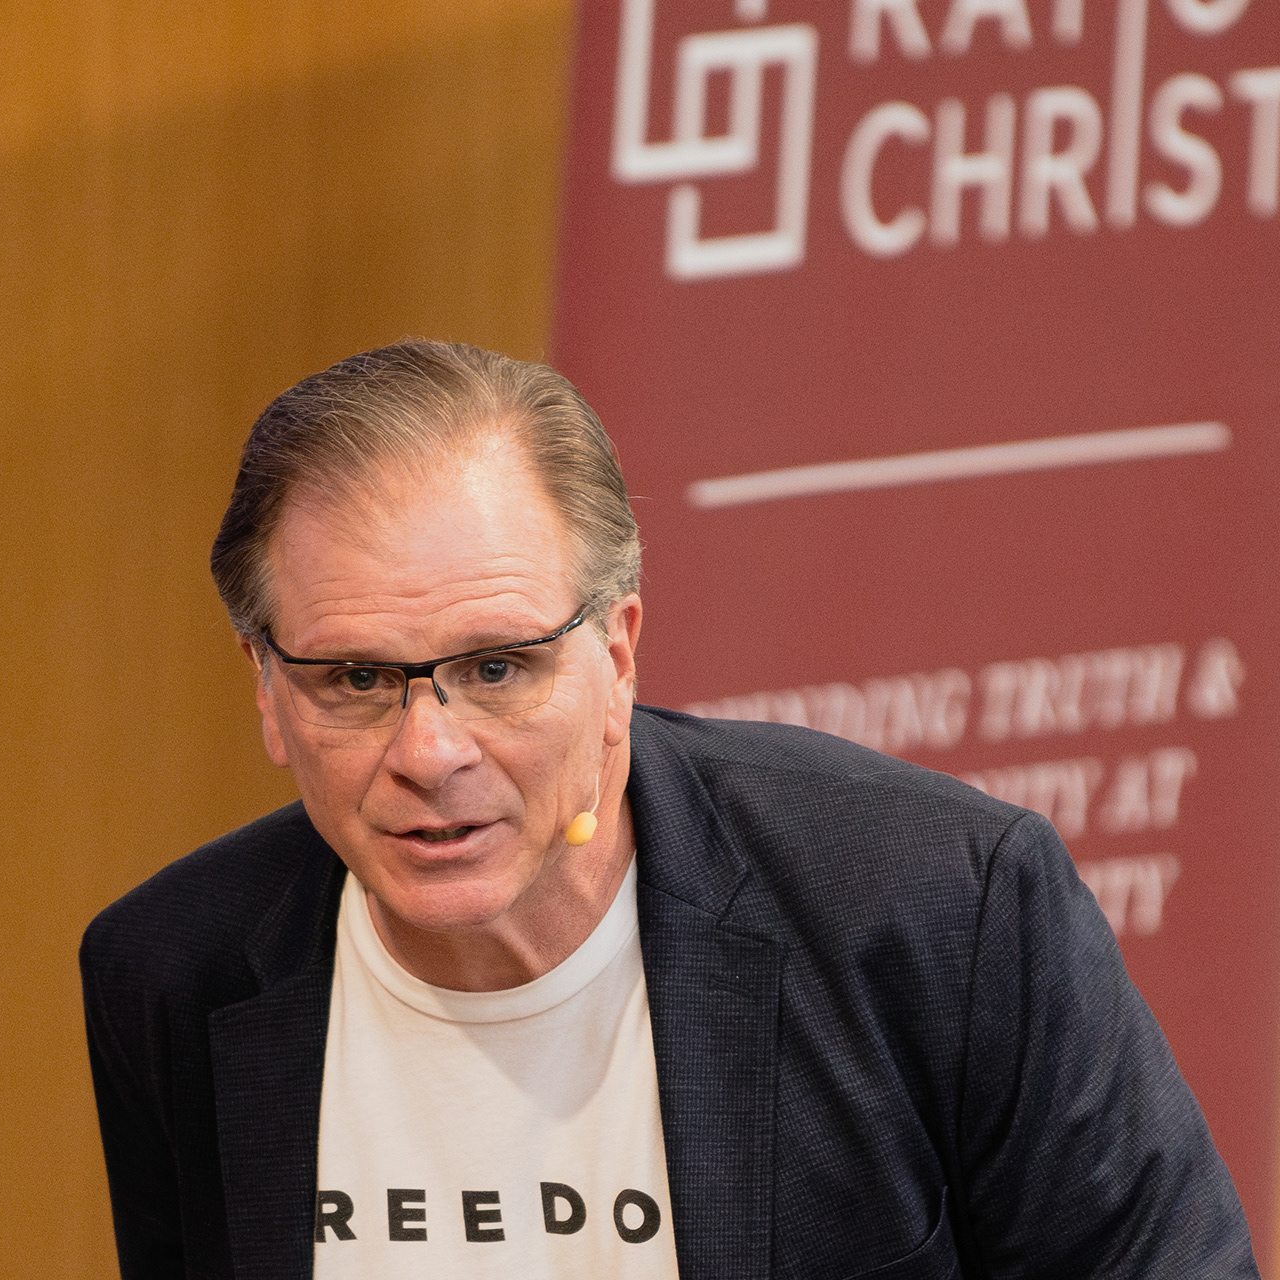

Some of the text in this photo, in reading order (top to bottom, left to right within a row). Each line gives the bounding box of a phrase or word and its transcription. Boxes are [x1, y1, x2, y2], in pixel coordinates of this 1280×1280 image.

[979, 643, 1186, 742] TRUTH
[1186, 638, 1246, 719] &
[315, 1182, 661, 1244] REEDO
